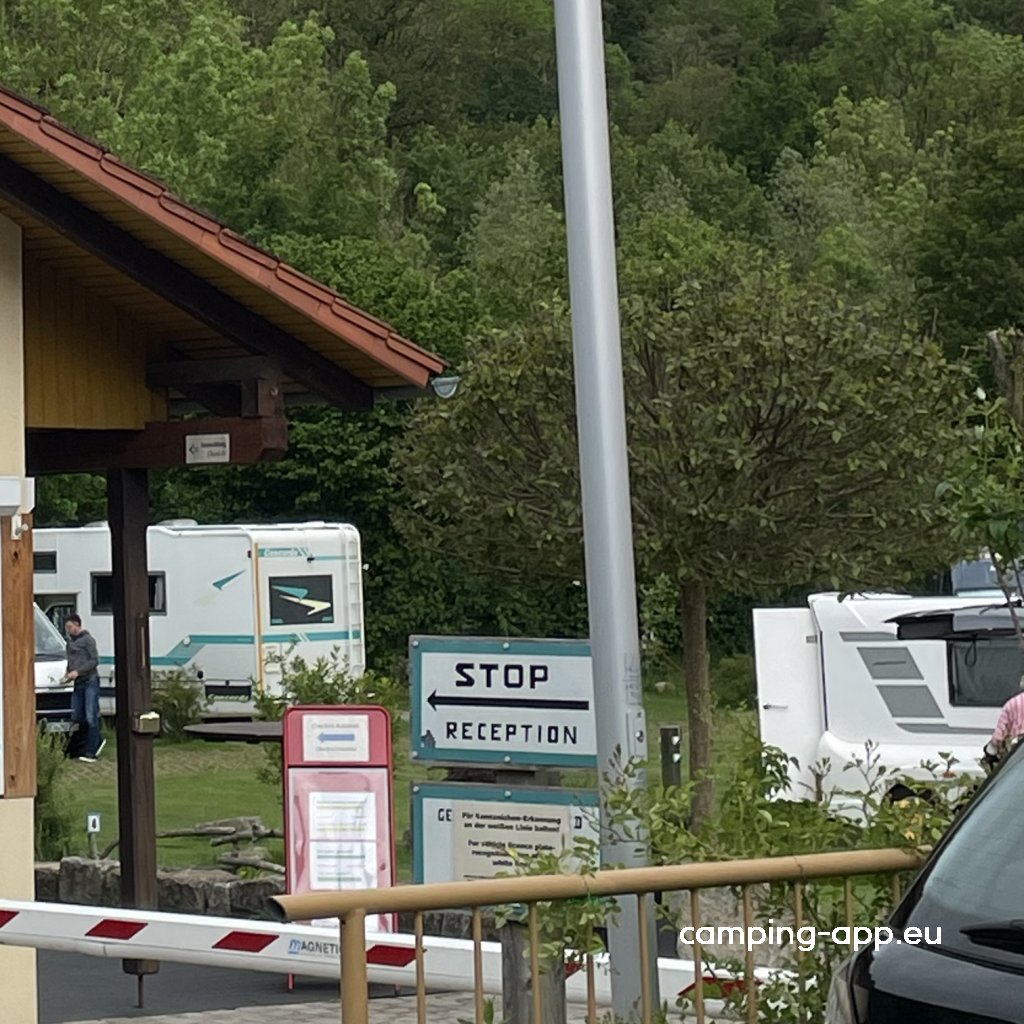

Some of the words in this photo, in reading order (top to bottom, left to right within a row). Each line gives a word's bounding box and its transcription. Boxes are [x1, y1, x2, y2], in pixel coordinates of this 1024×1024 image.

[455, 662, 549, 689] STOP
[446, 721, 577, 745] RECEPTION
[288, 938, 339, 955] MAGNETI
